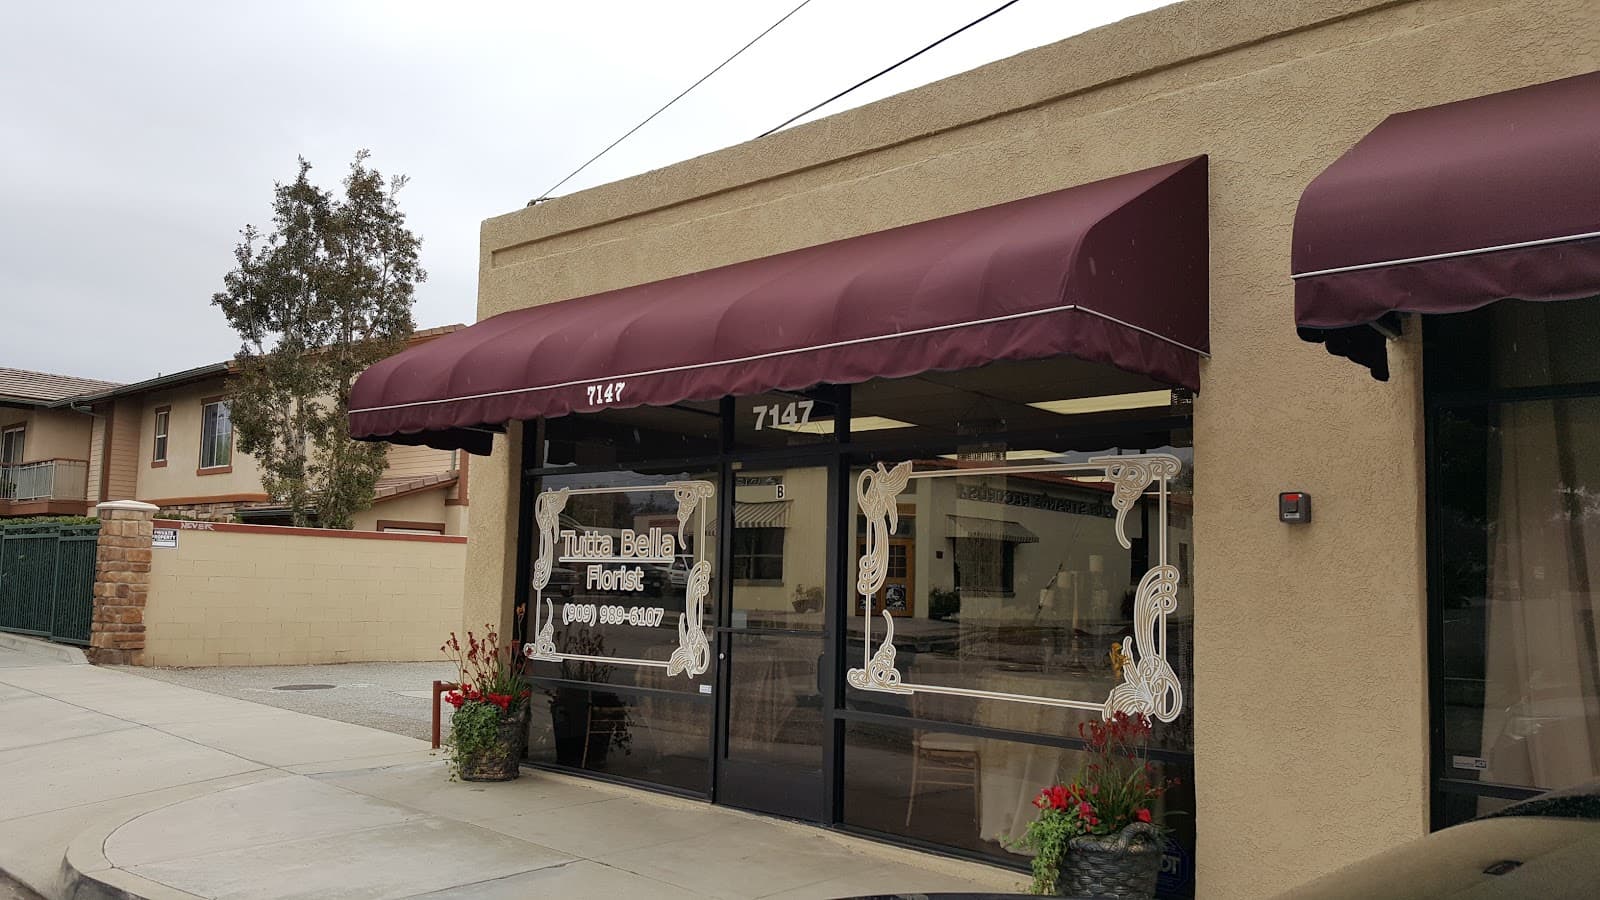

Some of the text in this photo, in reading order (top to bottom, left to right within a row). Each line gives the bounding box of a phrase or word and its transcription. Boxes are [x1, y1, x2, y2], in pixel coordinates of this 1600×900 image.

[587, 382, 626, 406] 7147
[753, 400, 814, 431] 7147
[777, 485, 784, 498] B
[560, 527, 676, 558] Tutta Bella
[586, 564, 644, 591] Florist
[562, 603, 664, 627] (909) 989-6107
[1160, 854, 1182, 875] DT
